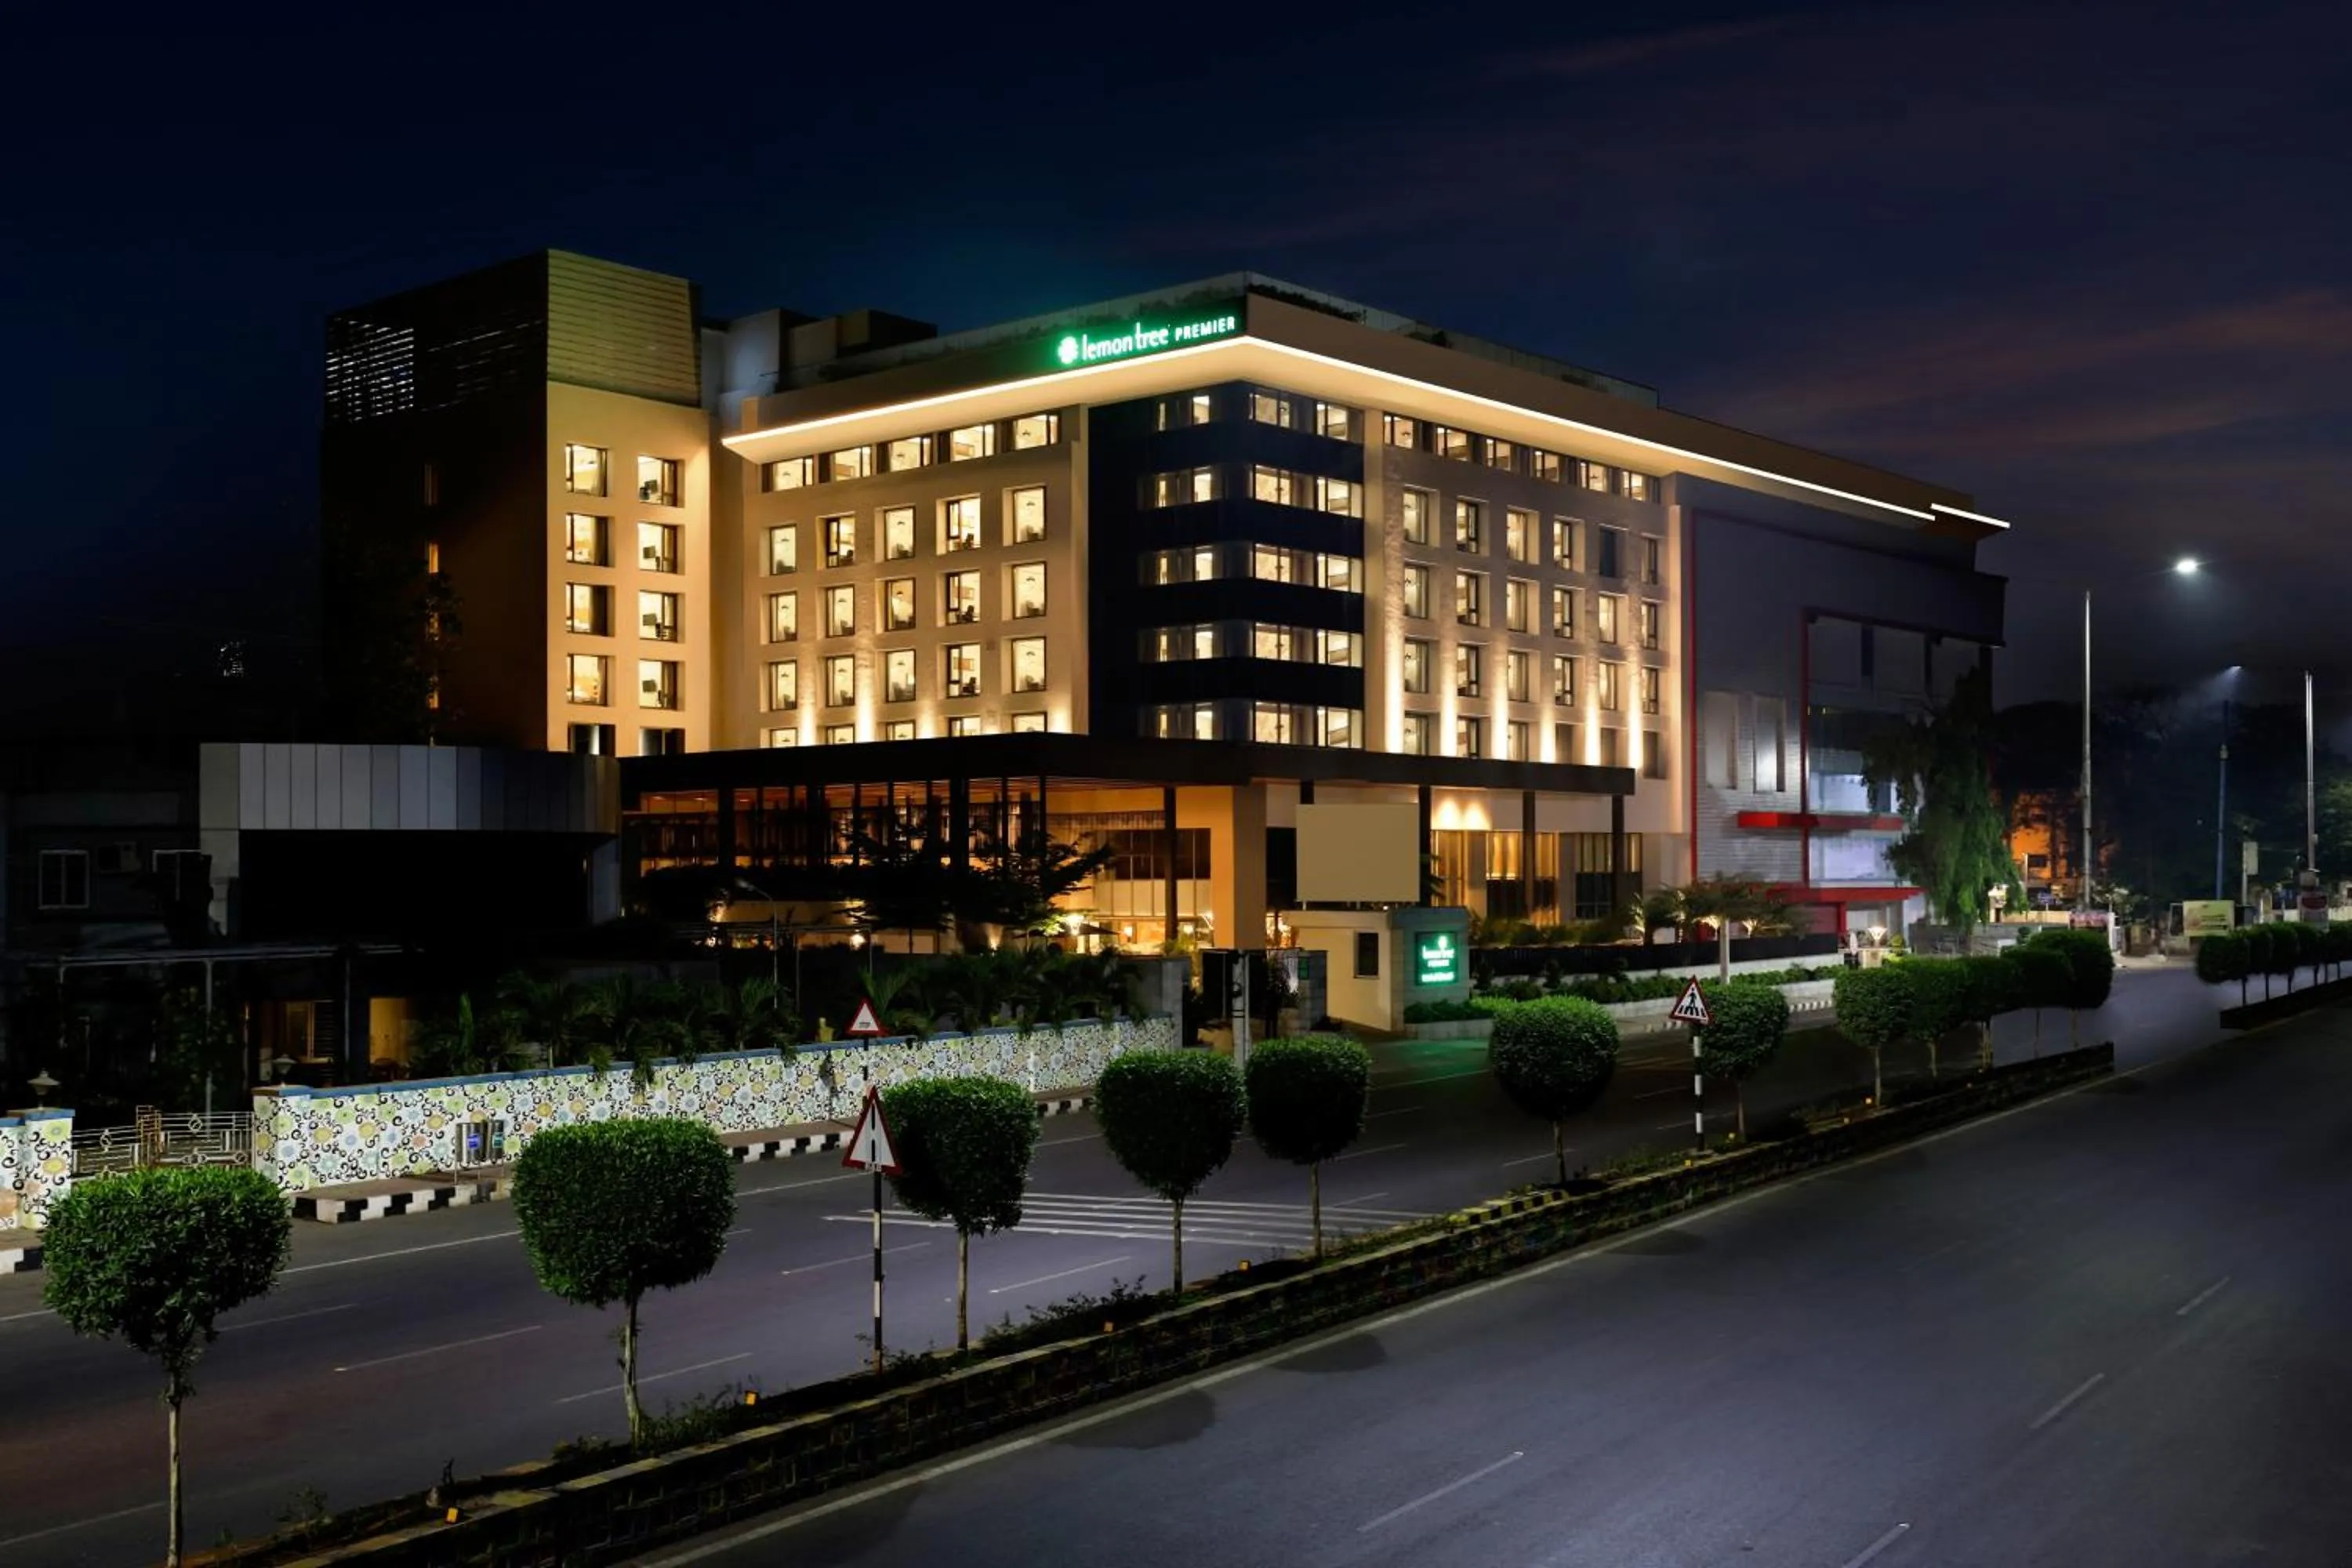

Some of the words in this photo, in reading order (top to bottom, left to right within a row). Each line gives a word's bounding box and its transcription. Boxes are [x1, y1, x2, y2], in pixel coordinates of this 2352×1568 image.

[1083, 334, 1133, 360] lemon
[1134, 322, 1169, 350] tree
[1175, 316, 1235, 341] PREMIER
